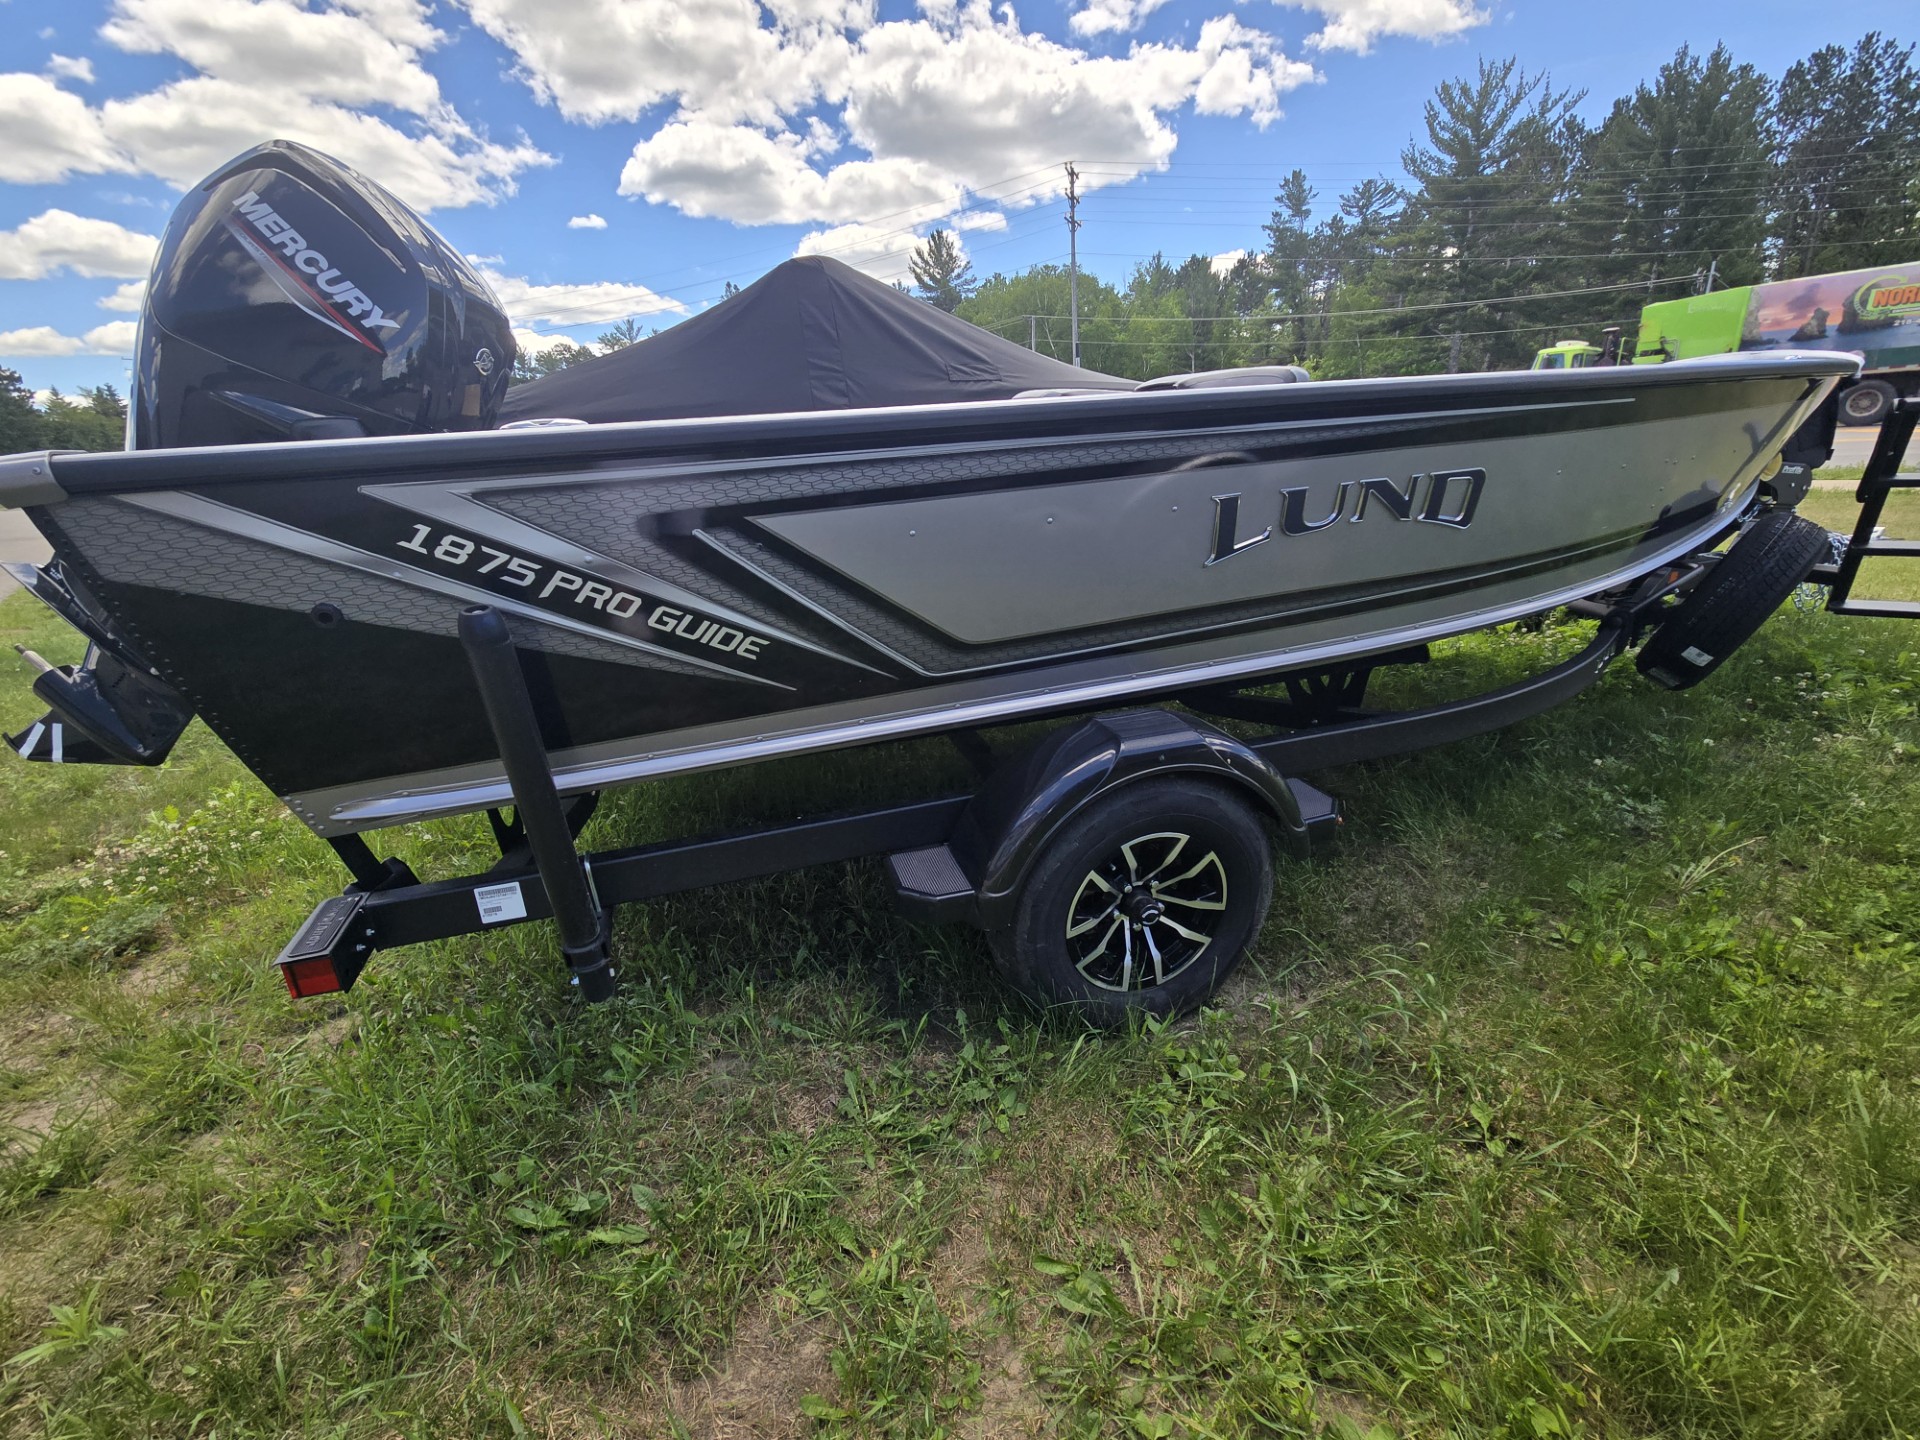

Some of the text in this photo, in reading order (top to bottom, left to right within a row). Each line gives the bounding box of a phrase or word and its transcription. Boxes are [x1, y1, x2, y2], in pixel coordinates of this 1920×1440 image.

[232, 191, 401, 329] MERCURY
[1872, 285, 1920, 308] NOR
[1203, 467, 1487, 568] LUND
[396, 523, 771, 660] 1875 PRO GUIDE
